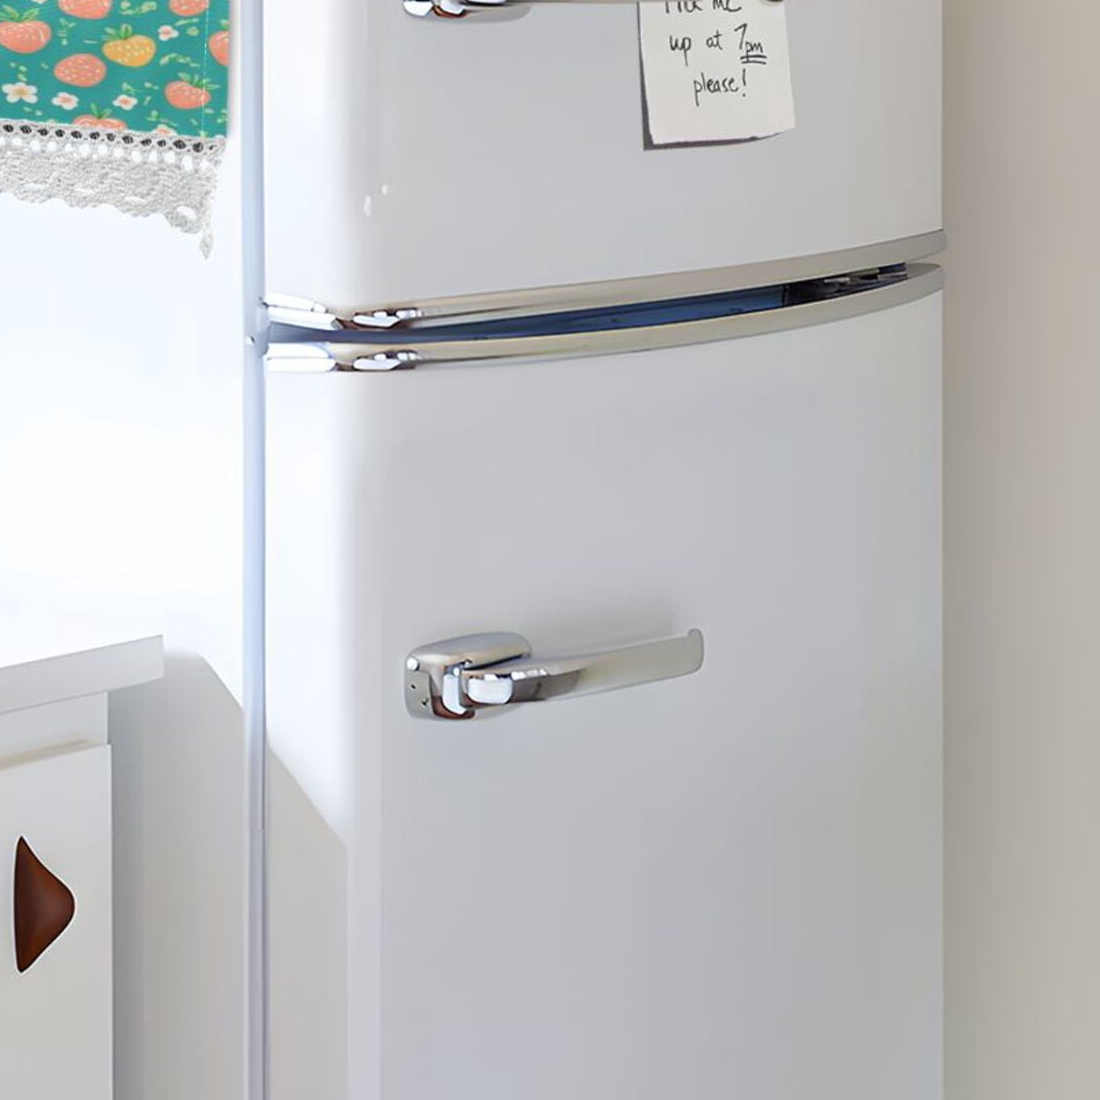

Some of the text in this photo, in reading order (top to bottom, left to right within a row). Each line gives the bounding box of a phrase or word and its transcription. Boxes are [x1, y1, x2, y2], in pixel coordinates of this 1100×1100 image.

[669, 35, 692, 67] up
[706, 30, 723, 51] at
[693, 68, 747, 108] please!
